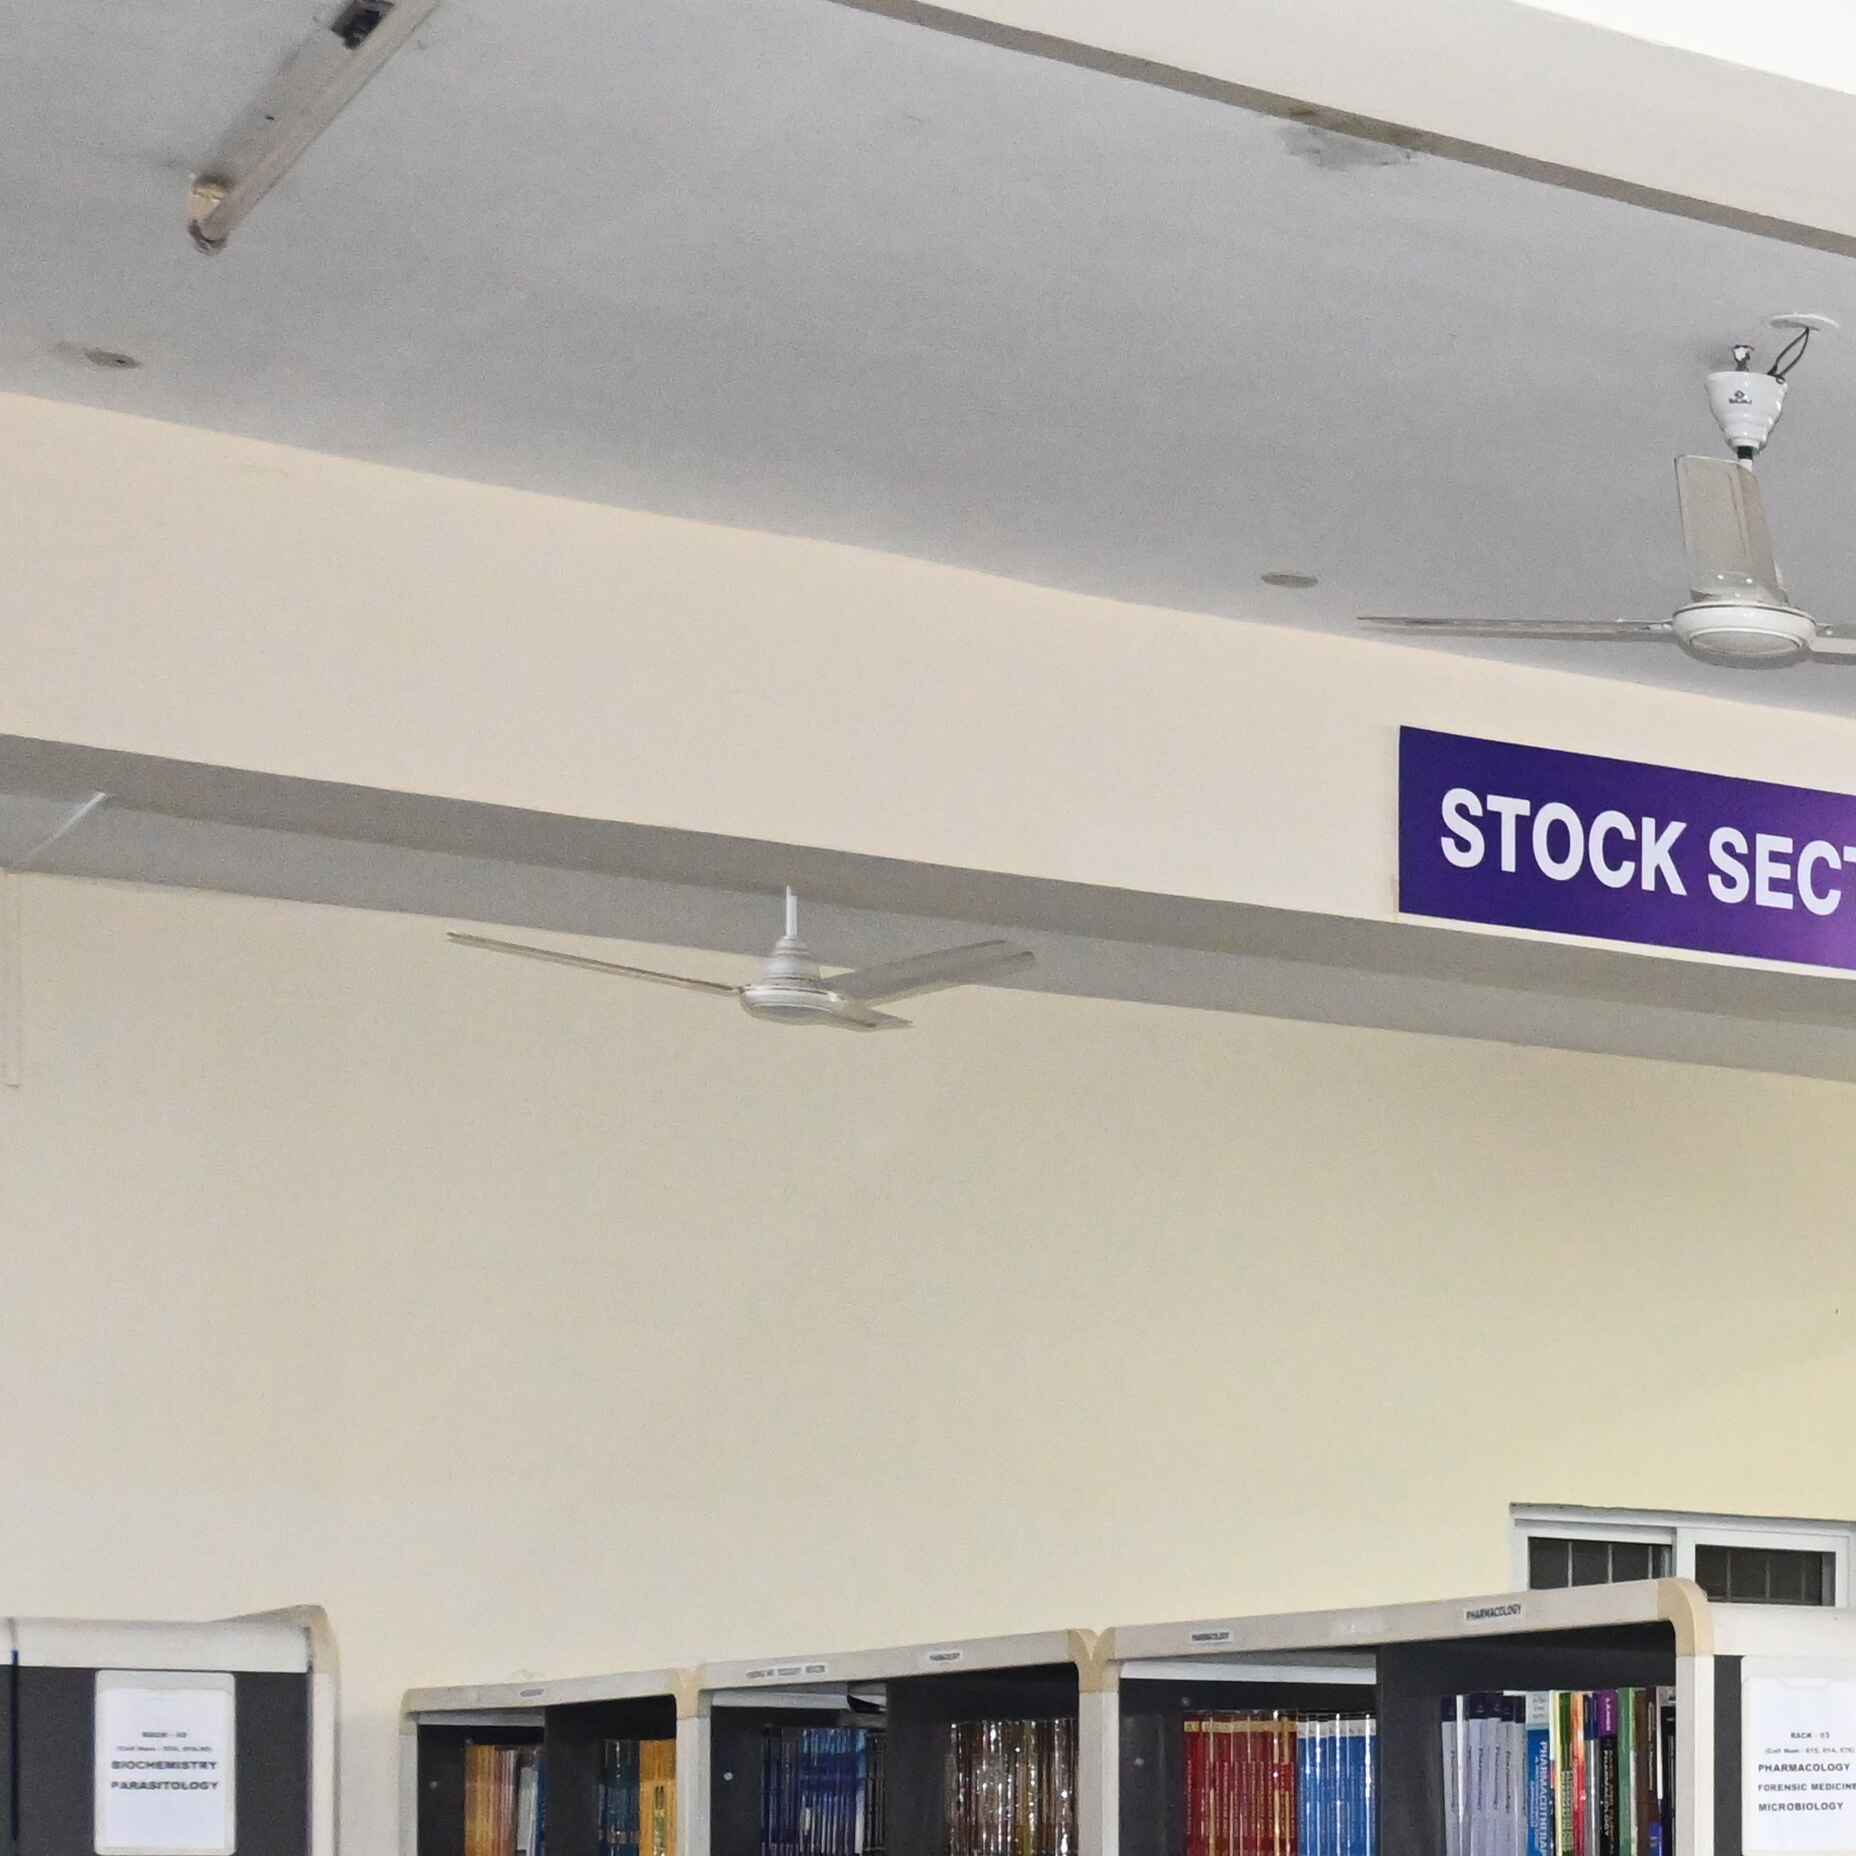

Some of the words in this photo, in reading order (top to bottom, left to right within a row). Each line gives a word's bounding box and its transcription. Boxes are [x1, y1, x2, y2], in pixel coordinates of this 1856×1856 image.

[1440, 787, 1687, 896] STOCK
[111, 1760, 217, 1770] BIOCHEMISTRY
[1758, 1763, 1850, 1772] PHARMACOLOGY
[111, 1781, 218, 1790] PARASITOLOGY
[1758, 1783, 1807, 1791] FORENSIC
[1758, 1802, 1844, 1811] MICROBIOLOGY
